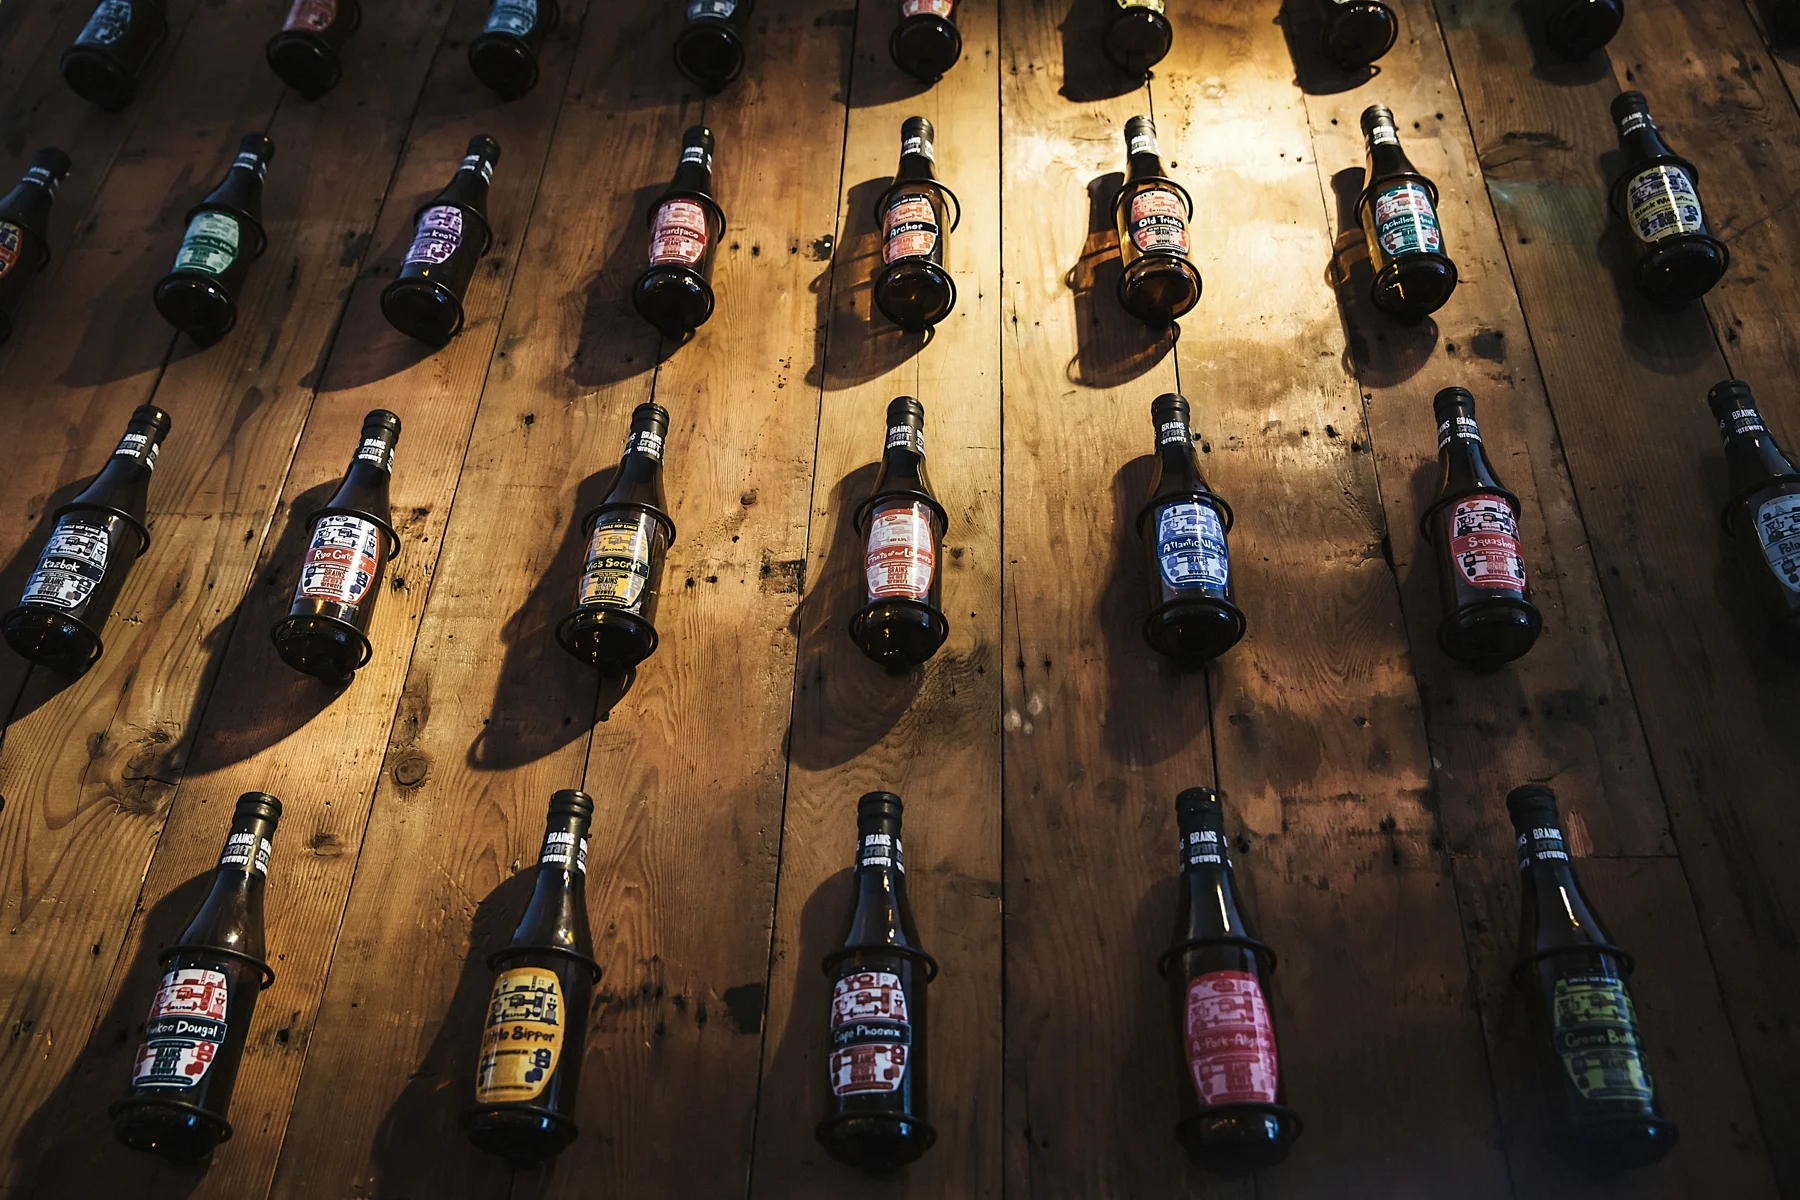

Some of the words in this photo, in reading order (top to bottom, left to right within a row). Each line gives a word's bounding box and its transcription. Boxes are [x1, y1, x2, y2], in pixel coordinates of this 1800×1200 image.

[1635, 202, 1655, 219] Black
[1656, 195, 1694, 206] Montain
[1138, 215, 1156, 228] Old
[1158, 215, 1183, 229] Tricks
[1382, 216, 1414, 232] Achilles
[890, 222, 923, 238] Archer
[1732, 408, 1757, 420] BRAINS
[1161, 422, 1185, 432] BRAINS
[1456, 416, 1478, 428] BRAINS
[889, 425, 912, 436] BRAINS
[124, 433, 148, 445] BRAINS
[364, 438, 386, 450] BRAINS
[641, 430, 663, 446] BRAINS
[1163, 538, 1200, 554] Atlantic
[1468, 537, 1516, 551] Squashed
[314, 549, 331, 561] Rye
[333, 550, 366, 568] Catcer
[905, 548, 931, 565] Laours
[41, 559, 82, 573] Kazbek
[605, 557, 642, 573] Secret
[229, 832, 256, 846] BRAINS
[547, 832, 575, 846] BRAINS
[865, 834, 891, 847] BRAINS
[1189, 830, 1218, 844] BRAINS
[1532, 828, 1562, 841] BRAINS
[176, 1019, 219, 1039] Dougal
[512, 1026, 554, 1043] Sipper
[856, 1024, 903, 1038] Phoenix
[1192, 1034, 1271, 1052] A-Pork-Alype
